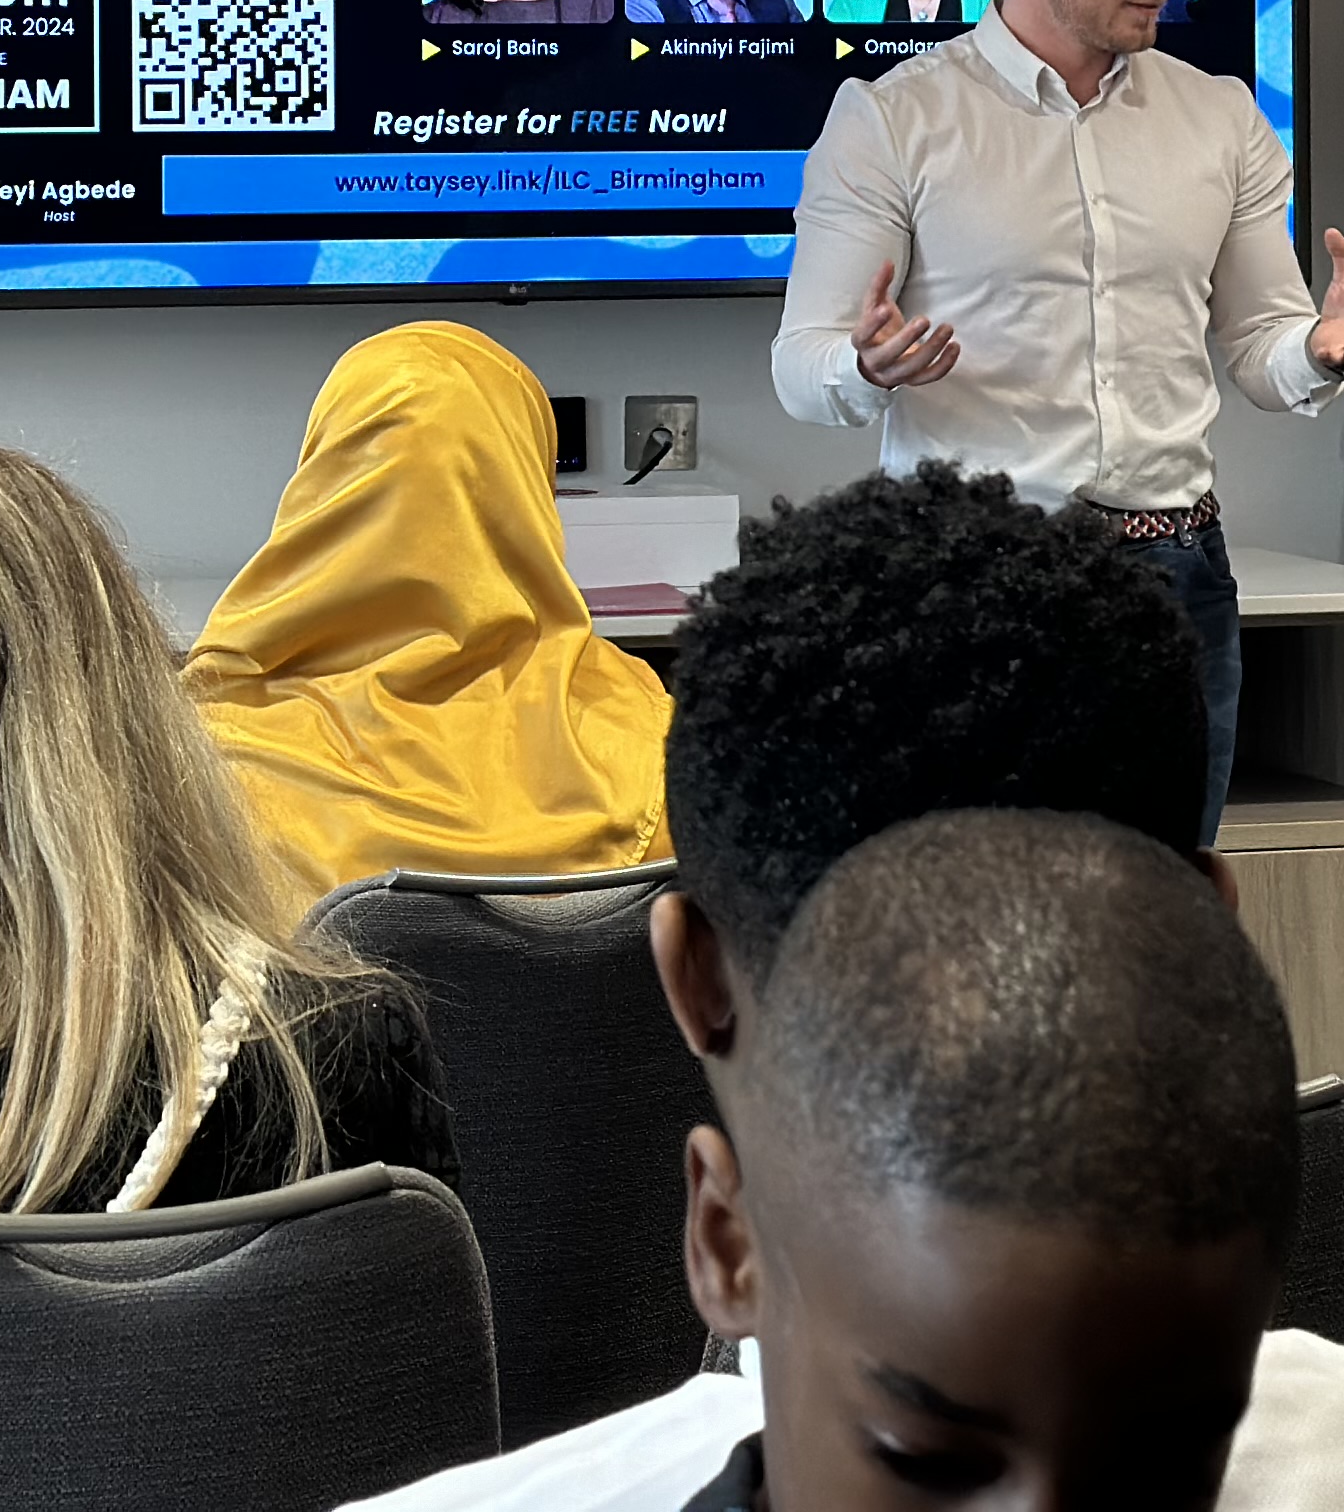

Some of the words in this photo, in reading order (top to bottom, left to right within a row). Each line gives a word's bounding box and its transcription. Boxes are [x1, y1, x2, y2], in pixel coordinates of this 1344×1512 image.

[22, 16, 75, 37] 2024
[451, 38, 501, 61] Saroj
[507, 38, 559, 56] Bains
[660, 38, 733, 60] Akinniyi
[738, 38, 795, 60] Fajimi
[373, 108, 508, 143] Register
[516, 107, 562, 136] for
[570, 110, 640, 134] FREE
[648, 107, 728, 134] Now!
[41, 179, 136, 206] Agbede
[335, 164, 766, 199] www.taysey.link/ILC_Birmingham
[43, 210, 76, 224] Host
